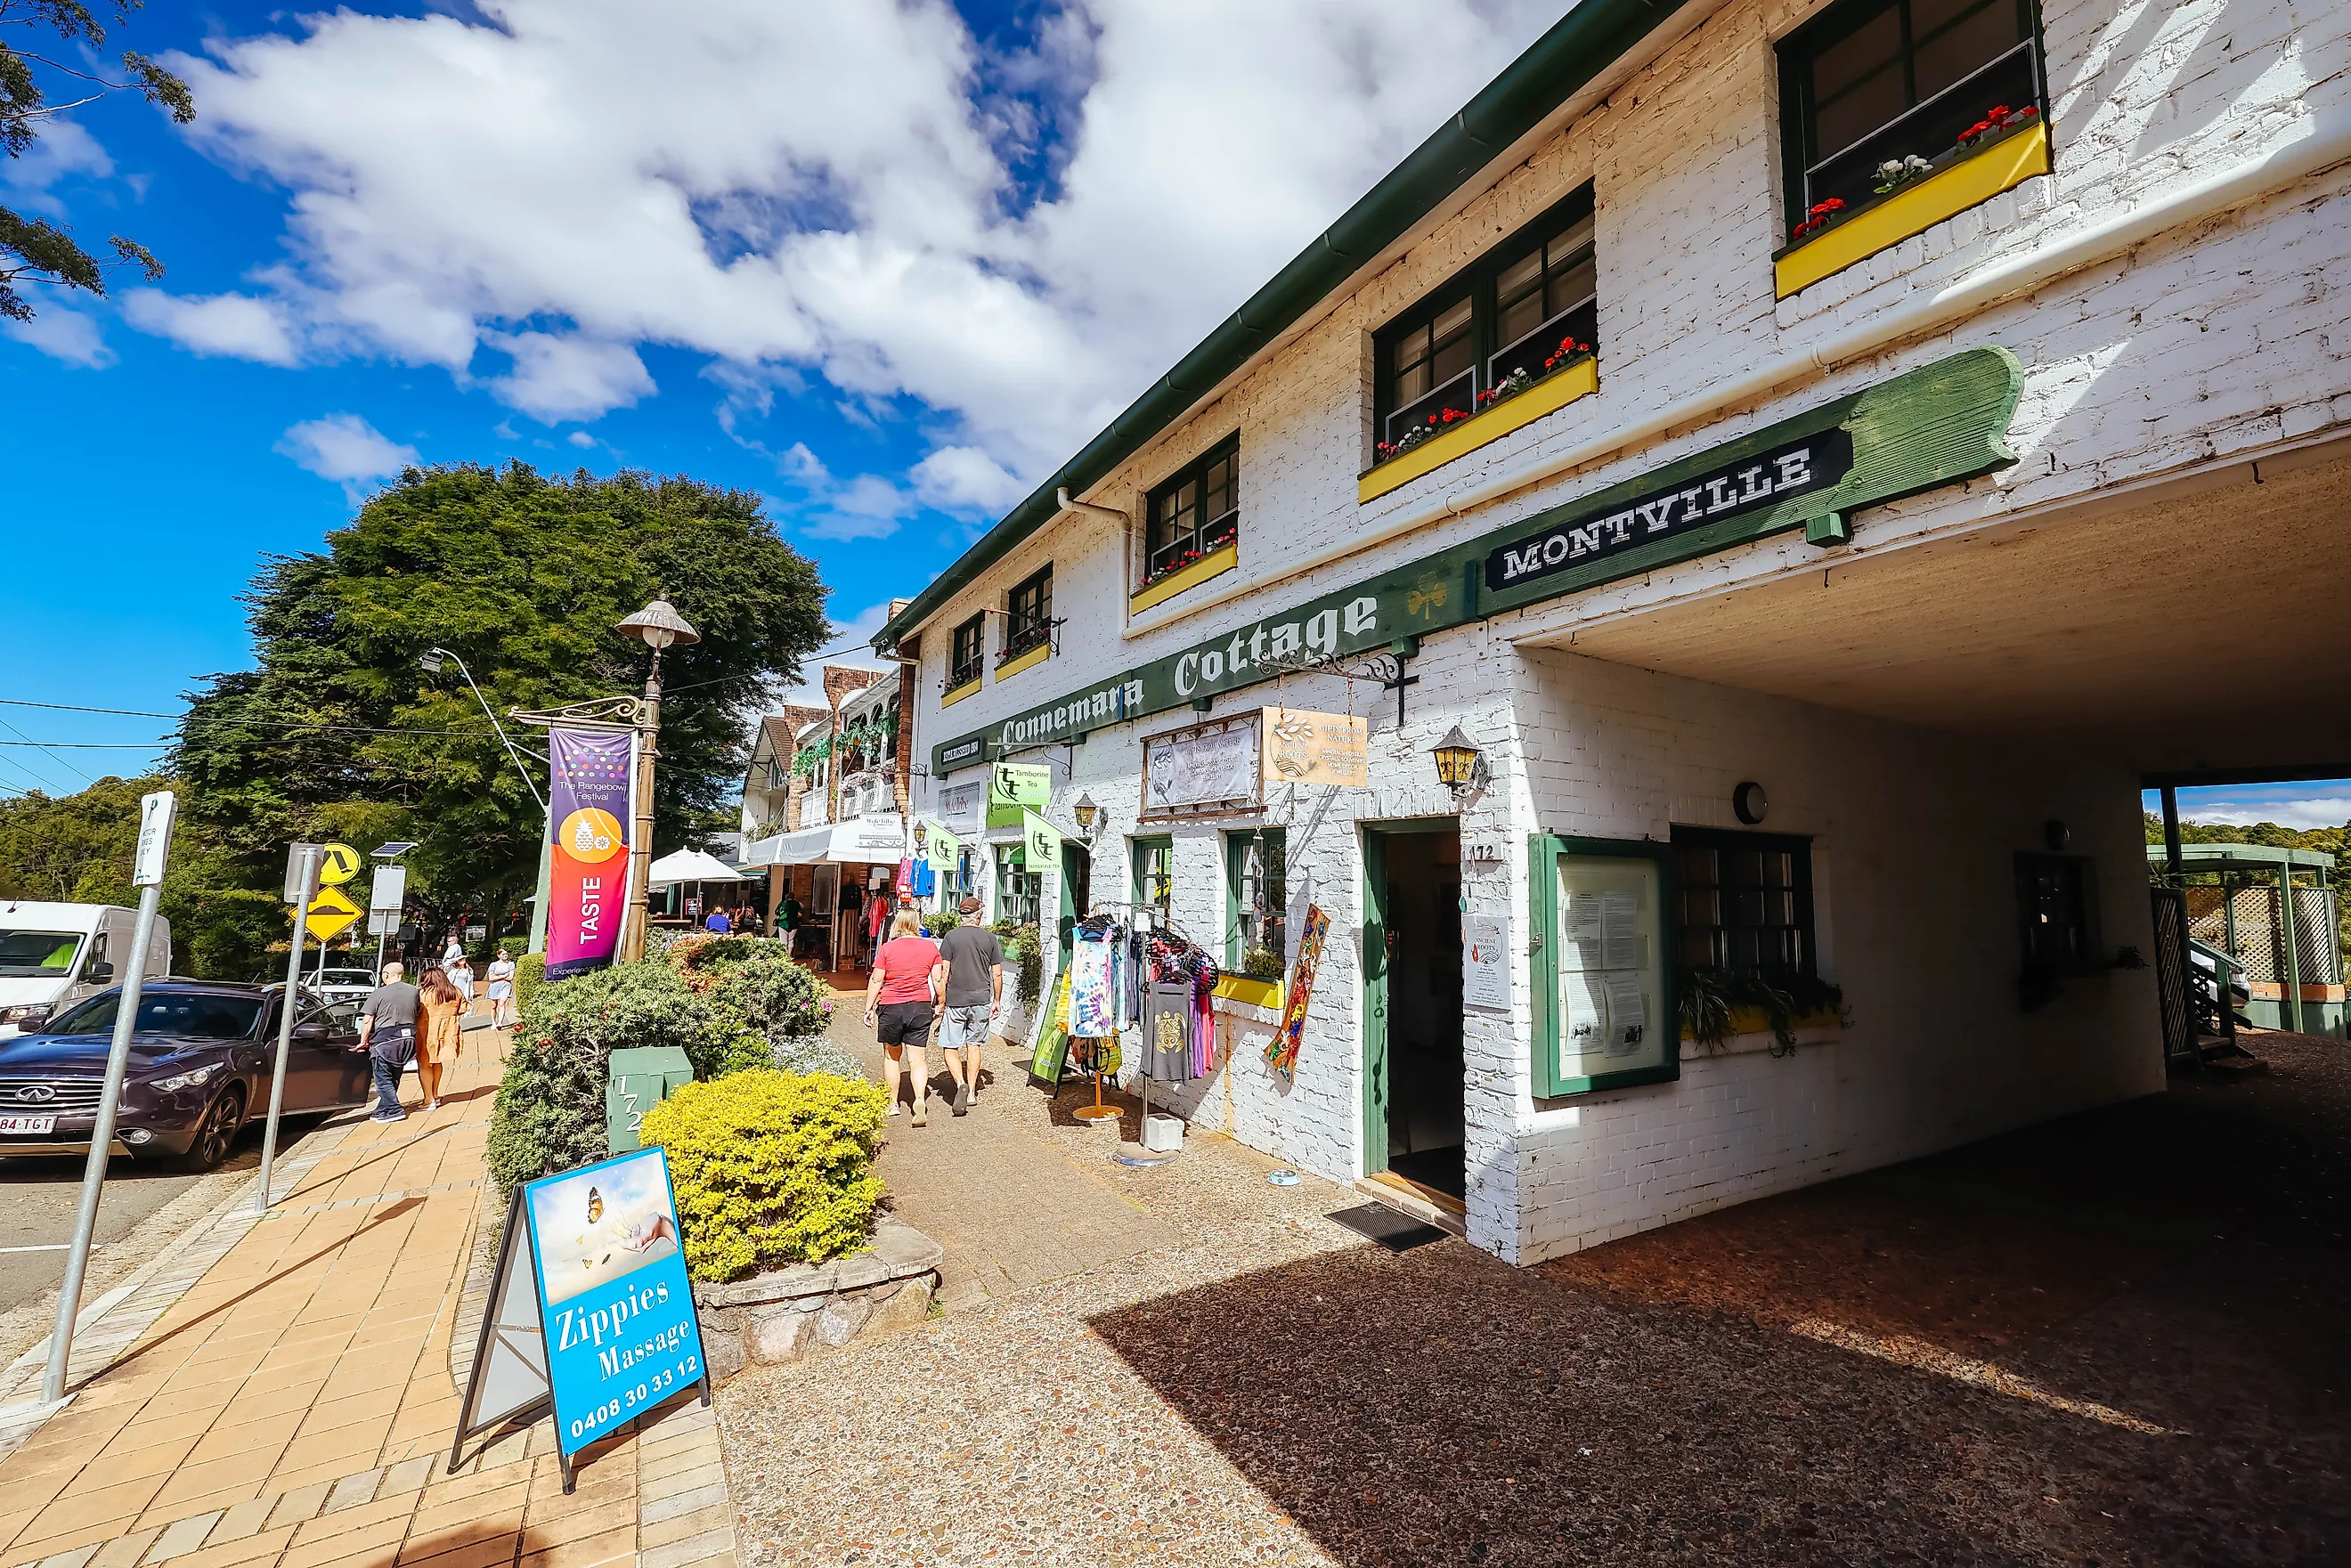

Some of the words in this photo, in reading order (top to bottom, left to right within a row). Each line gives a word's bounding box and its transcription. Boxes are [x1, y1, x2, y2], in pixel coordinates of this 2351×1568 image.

[1503, 447, 1810, 580] MONTVILLE
[1002, 678, 1145, 751] Connemara
[1174, 597, 1378, 696] Cottage
[1319, 724, 1339, 734] GIFTS
[1342, 726, 1363, 735] FROM
[1327, 735, 1356, 744] NATURE
[1280, 751, 1307, 760] ROOTS
[1015, 769, 1049, 778] Tamborine
[559, 781, 575, 790] The
[578, 782, 624, 792] Rangebow
[576, 792, 609, 800] Festival
[1469, 844, 1494, 861] 172
[580, 876, 601, 945] TASTE
[556, 1280, 670, 1353] Zippies
[597, 1320, 690, 1382] Massage
[571, 1398, 622, 1438] 0408
[624, 1383, 647, 1408] 30
[651, 1369, 673, 1393] 33
[677, 1355, 697, 1377] 12
